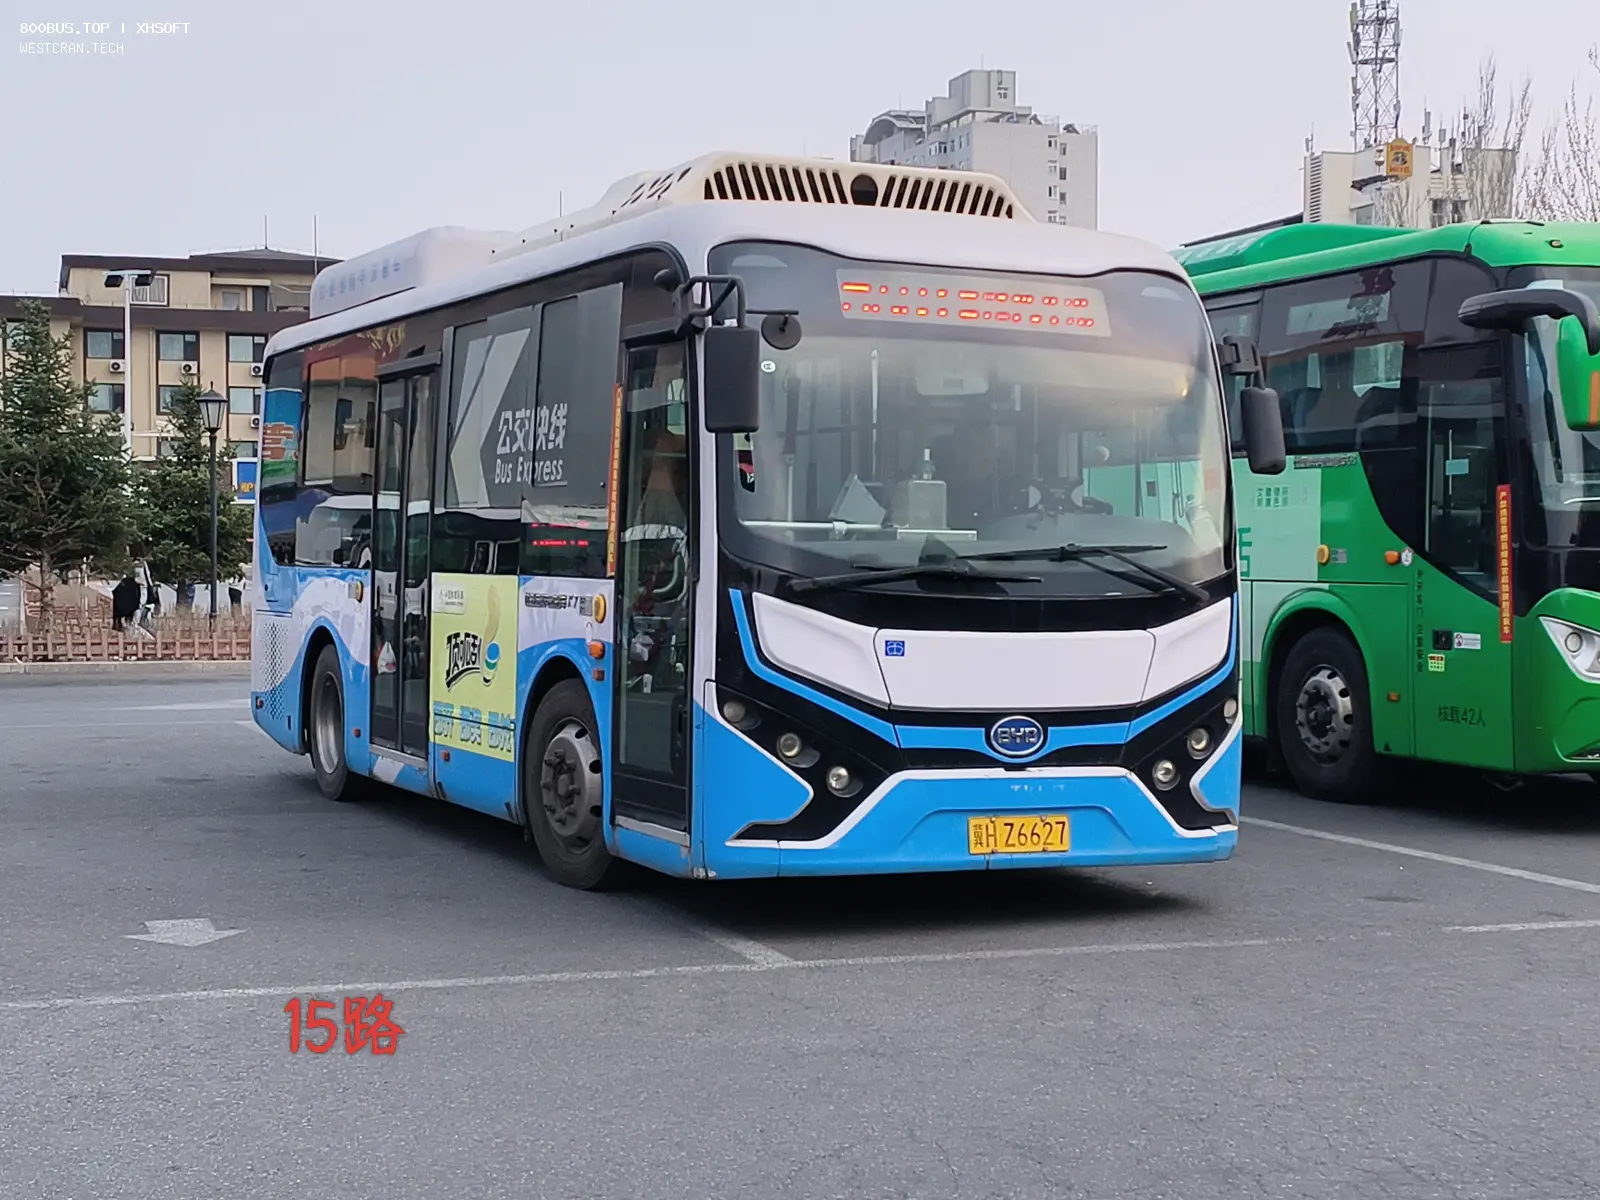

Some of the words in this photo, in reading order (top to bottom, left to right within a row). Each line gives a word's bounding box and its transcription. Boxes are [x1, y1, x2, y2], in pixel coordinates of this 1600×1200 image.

[496, 403, 567, 455] 公交快线
[495, 459, 513, 484] Bus
[516, 457, 563, 484] Express
